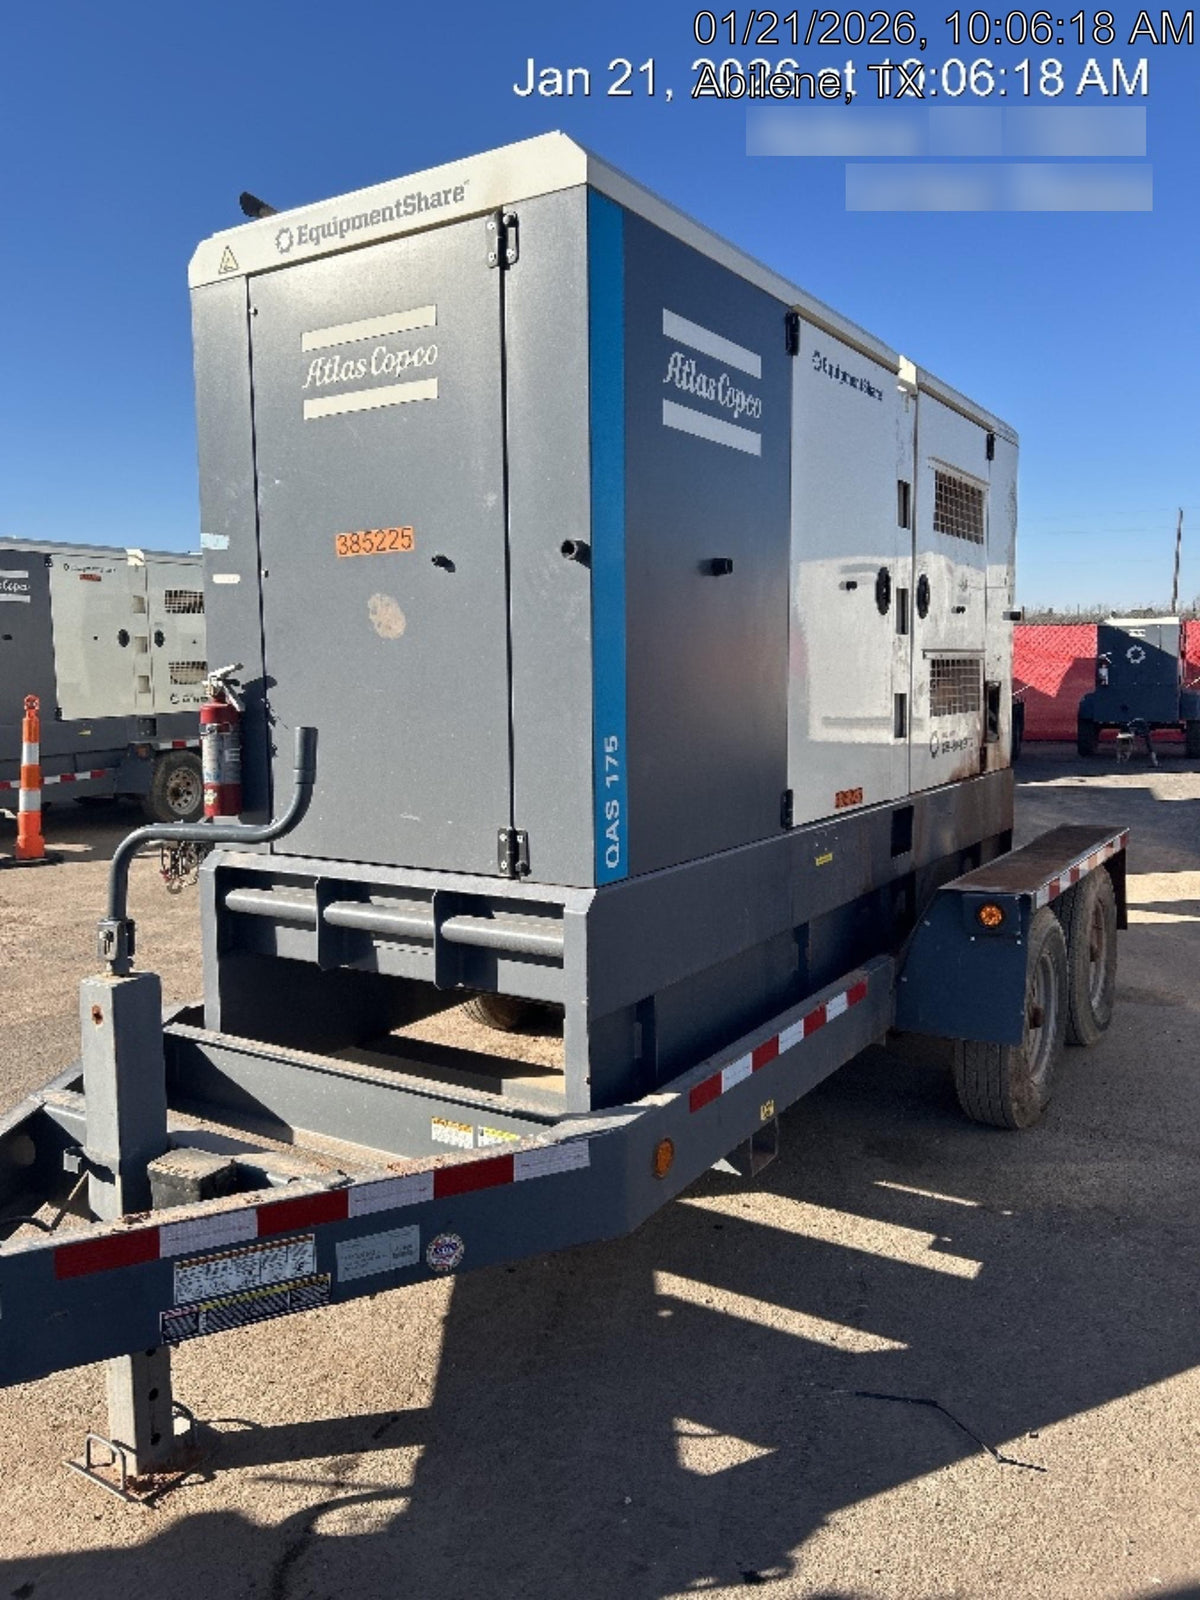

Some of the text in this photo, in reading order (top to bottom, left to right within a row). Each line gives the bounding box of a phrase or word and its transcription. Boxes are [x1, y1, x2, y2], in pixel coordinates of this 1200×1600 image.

[297, 183, 466, 247] EquipmentShare
[303, 344, 438, 389] Atlas Copco
[663, 351, 762, 419] Atlas Copco
[337, 527, 413, 556] 385225
[604, 735, 620, 869] QAS 175
